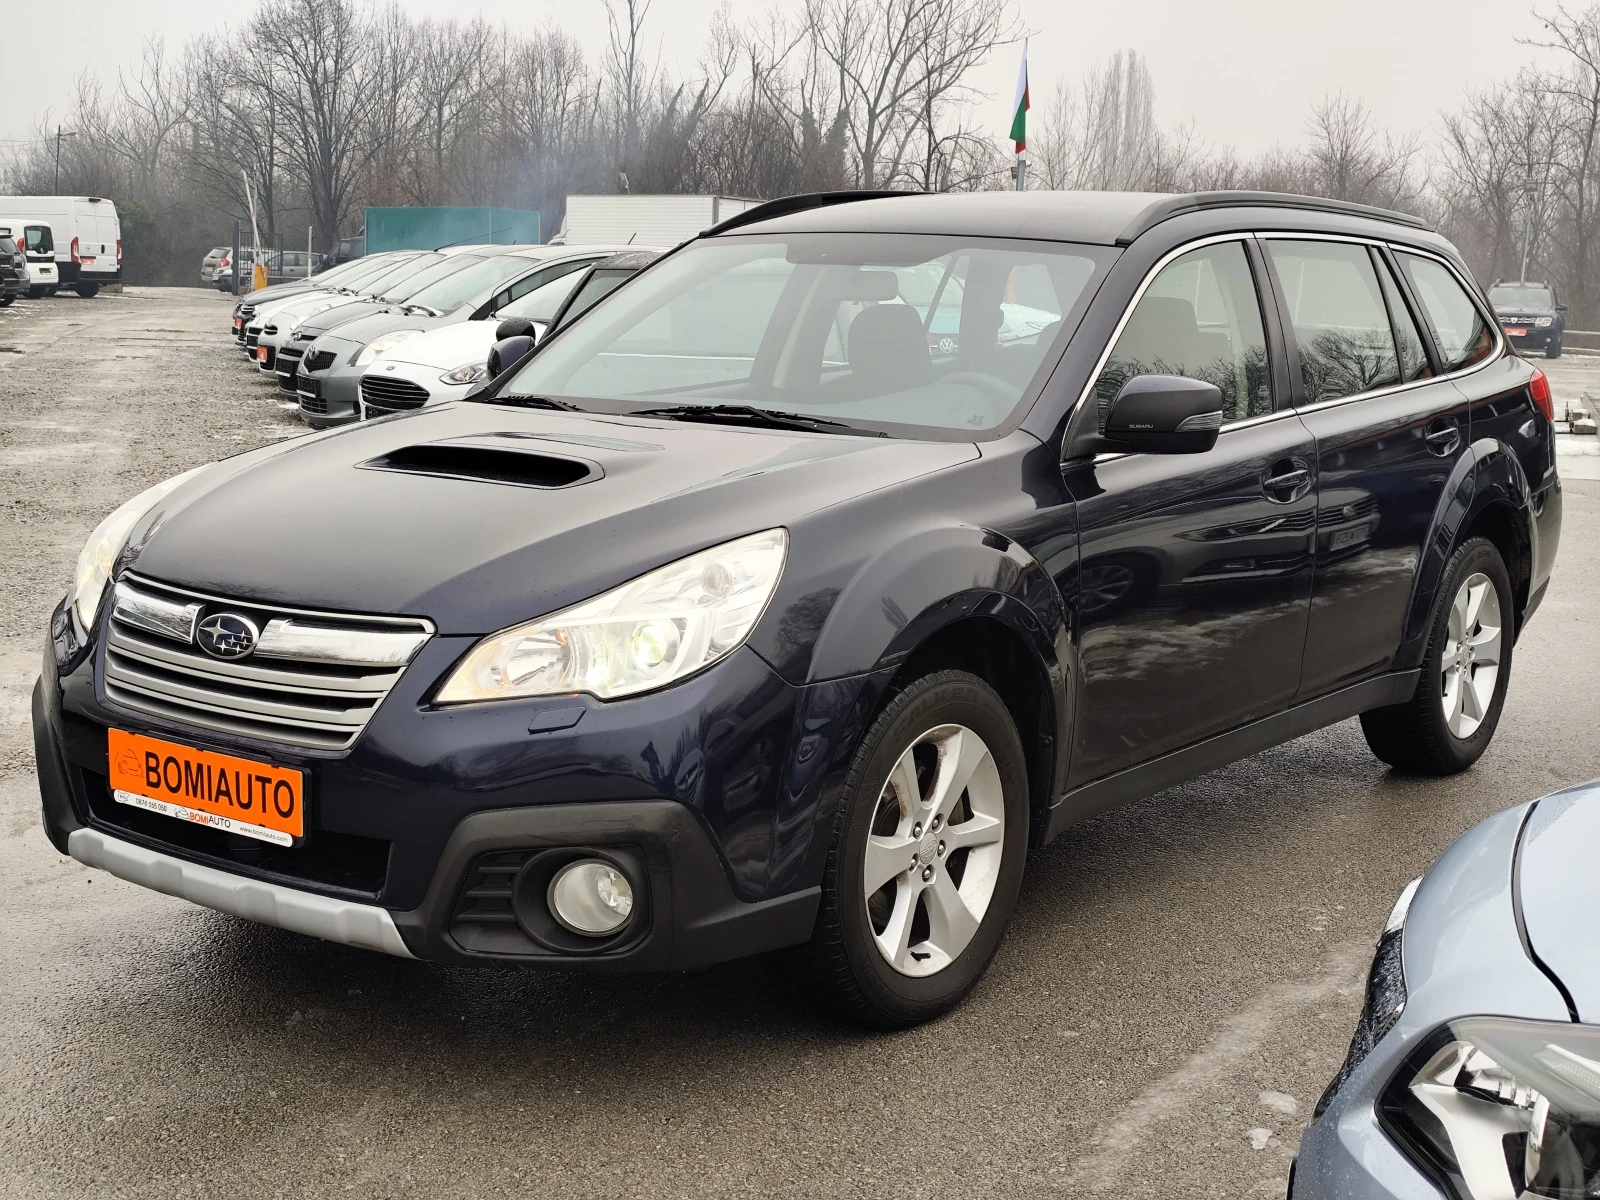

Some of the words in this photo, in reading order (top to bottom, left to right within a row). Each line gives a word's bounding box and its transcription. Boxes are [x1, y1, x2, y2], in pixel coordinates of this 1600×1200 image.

[940, 338, 953, 353] VW
[145, 751, 295, 819] BOMIAUTO
[189, 812, 231, 828] BOMIAUTO
[239, 826, 289, 843] www.bomiauto.com
